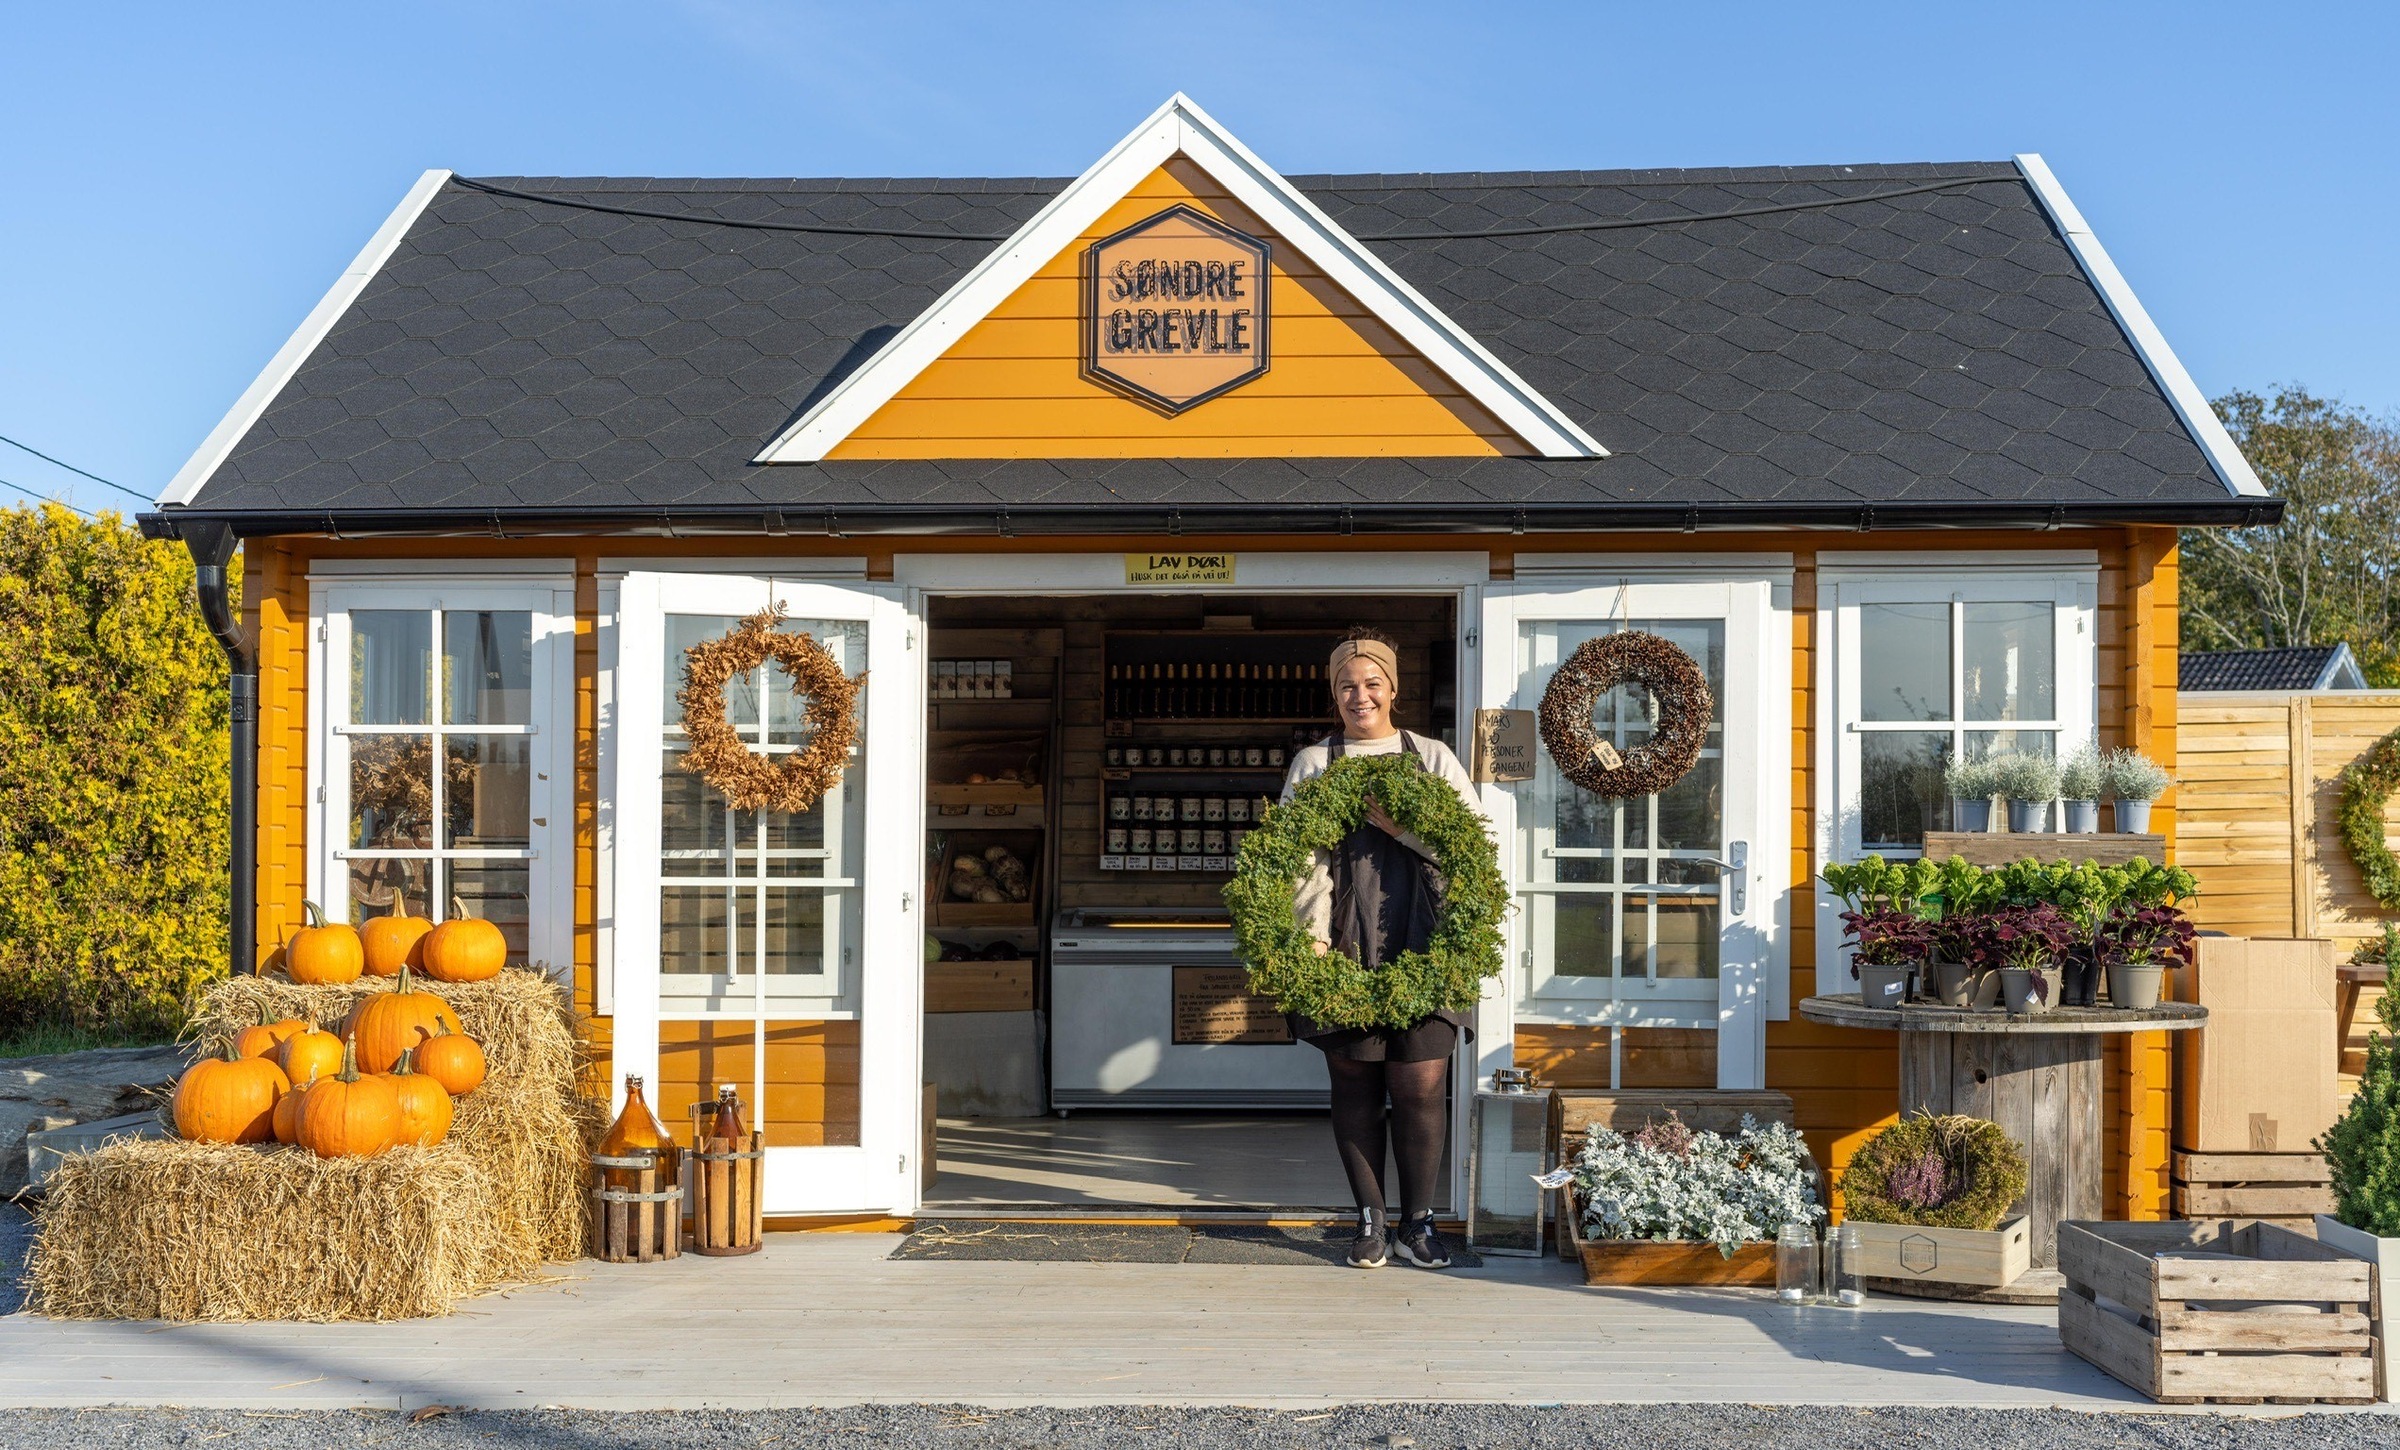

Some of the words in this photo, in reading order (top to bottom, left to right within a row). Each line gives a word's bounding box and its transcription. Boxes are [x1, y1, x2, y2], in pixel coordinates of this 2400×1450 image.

[1114, 258, 1245, 298] SØNDRE
[1111, 307, 1250, 350] GREVLE
[1149, 555, 1181, 570] LAV
[1188, 555, 1226, 569] DØR!
[1131, 572, 1152, 582] HUSK
[1155, 572, 1168, 581] DET
[1172, 570, 1189, 580] OGSÅ
[1217, 570, 1230, 580] UT!
[1485, 714, 1511, 729] MAKS
[1481, 744, 1524, 759] PERSONER
[1489, 761, 1530, 774] GANGEN!
